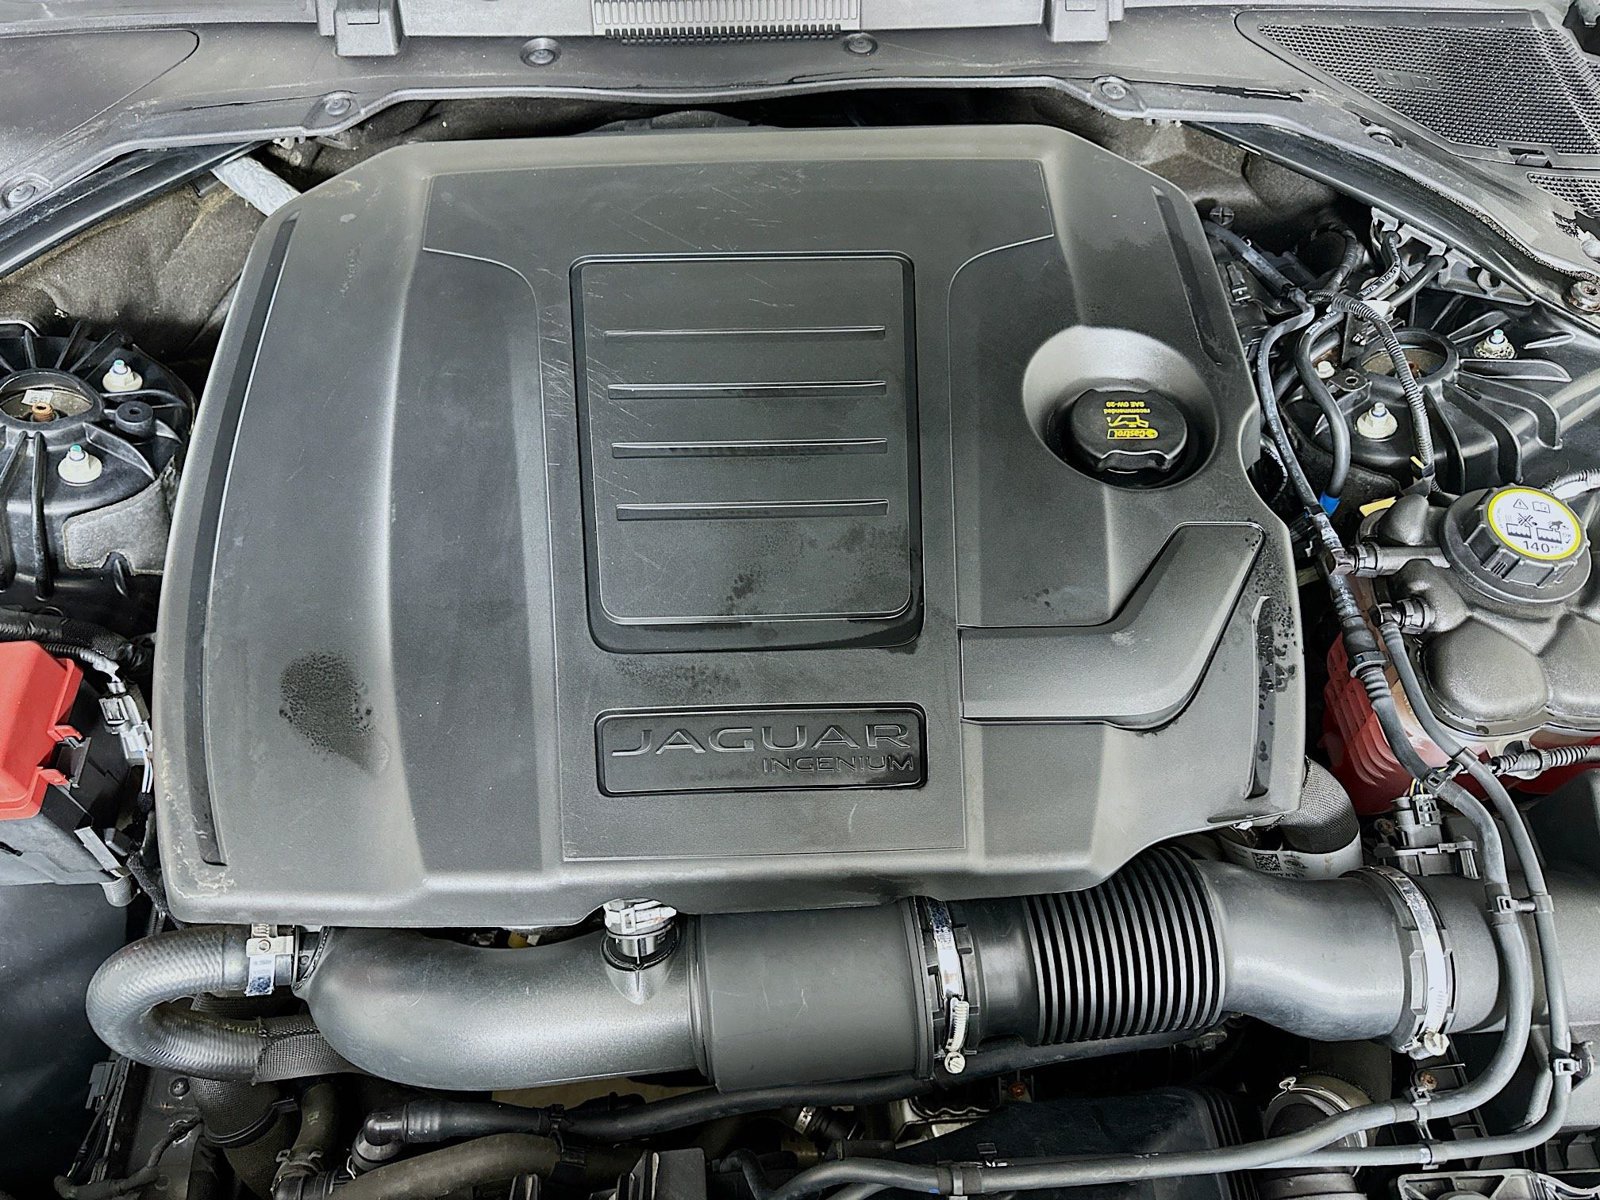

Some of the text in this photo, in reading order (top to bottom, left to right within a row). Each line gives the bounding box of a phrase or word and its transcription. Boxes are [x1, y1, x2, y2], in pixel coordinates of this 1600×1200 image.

[1114, 430, 1146, 438] Castrol
[1523, 540, 1550, 553] 140
[611, 724, 911, 757] JAGUAR
[762, 755, 914, 773] INGENIUM
